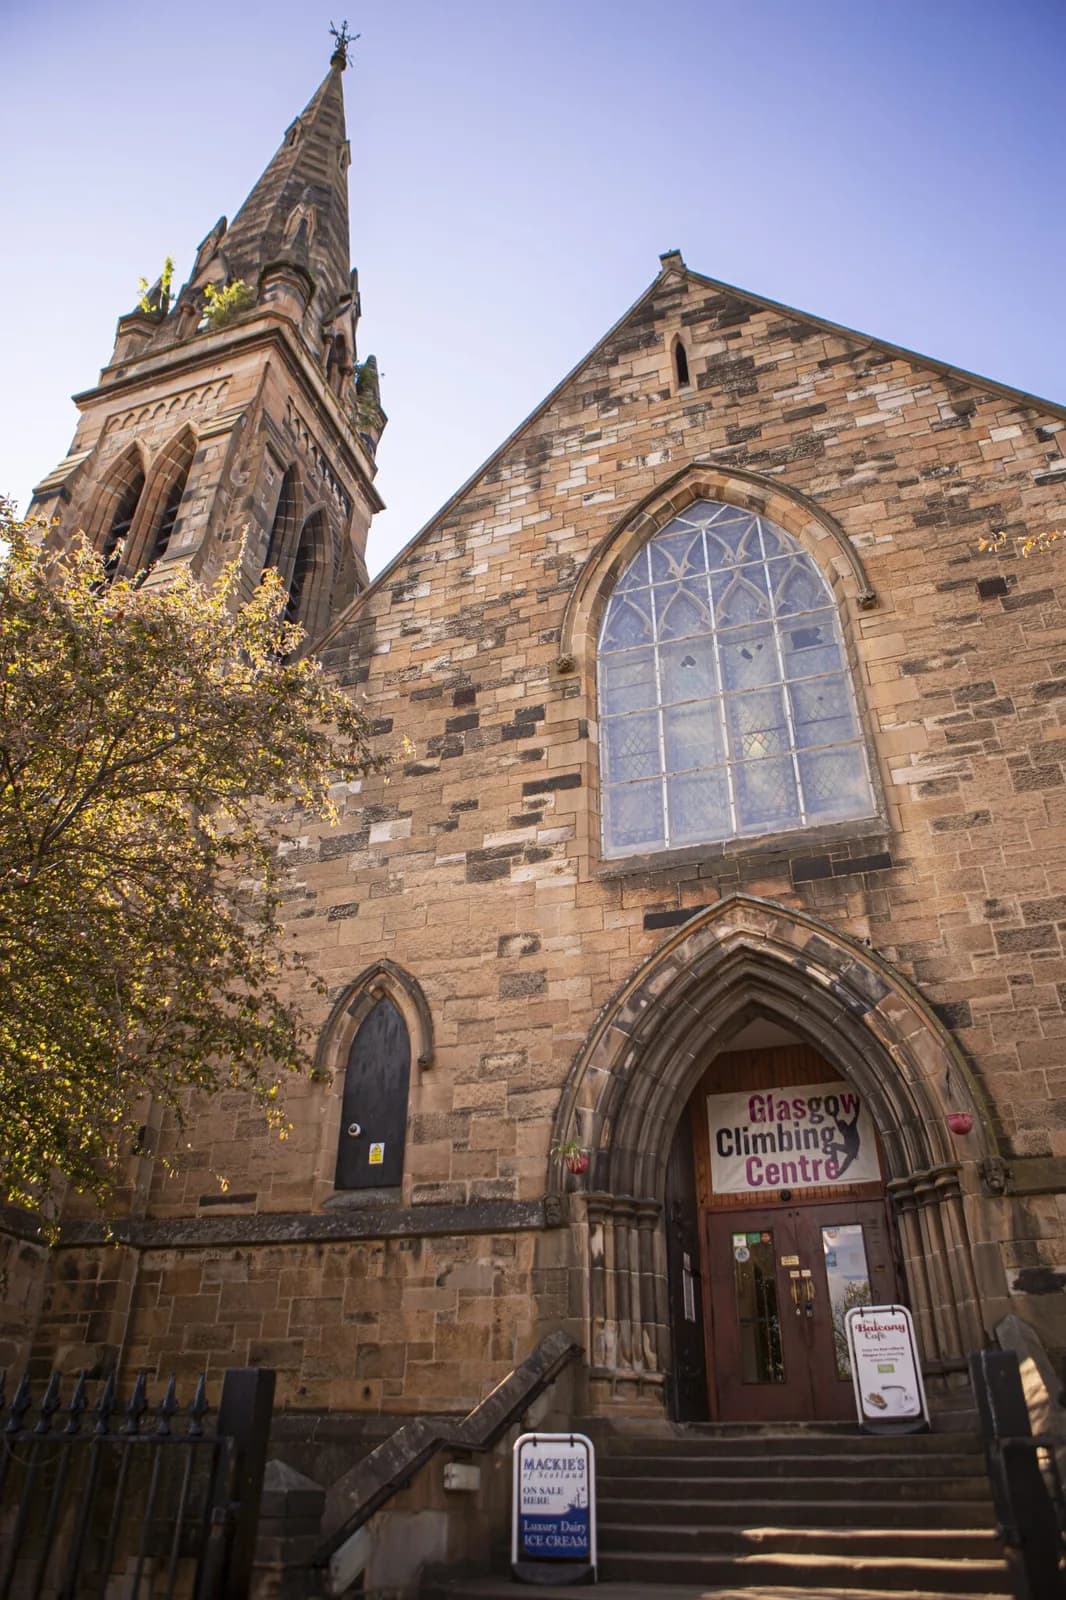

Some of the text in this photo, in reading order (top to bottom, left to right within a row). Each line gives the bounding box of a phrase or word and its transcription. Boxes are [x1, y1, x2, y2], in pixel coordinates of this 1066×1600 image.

[748, 1093, 860, 1124] Glasgow
[716, 1121, 836, 1157] Climbing
[745, 1156, 840, 1187] Centre
[855, 1319, 905, 1333] Balcony
[523, 1457, 585, 1471] MACKIE'S
[523, 1470, 584, 1480] of Scotland
[523, 1486, 563, 1495] ON SALE
[523, 1495, 550, 1505] HERE
[524, 1519, 587, 1534] Luxury Dairy
[524, 1534, 588, 1547] ICE CREAM
